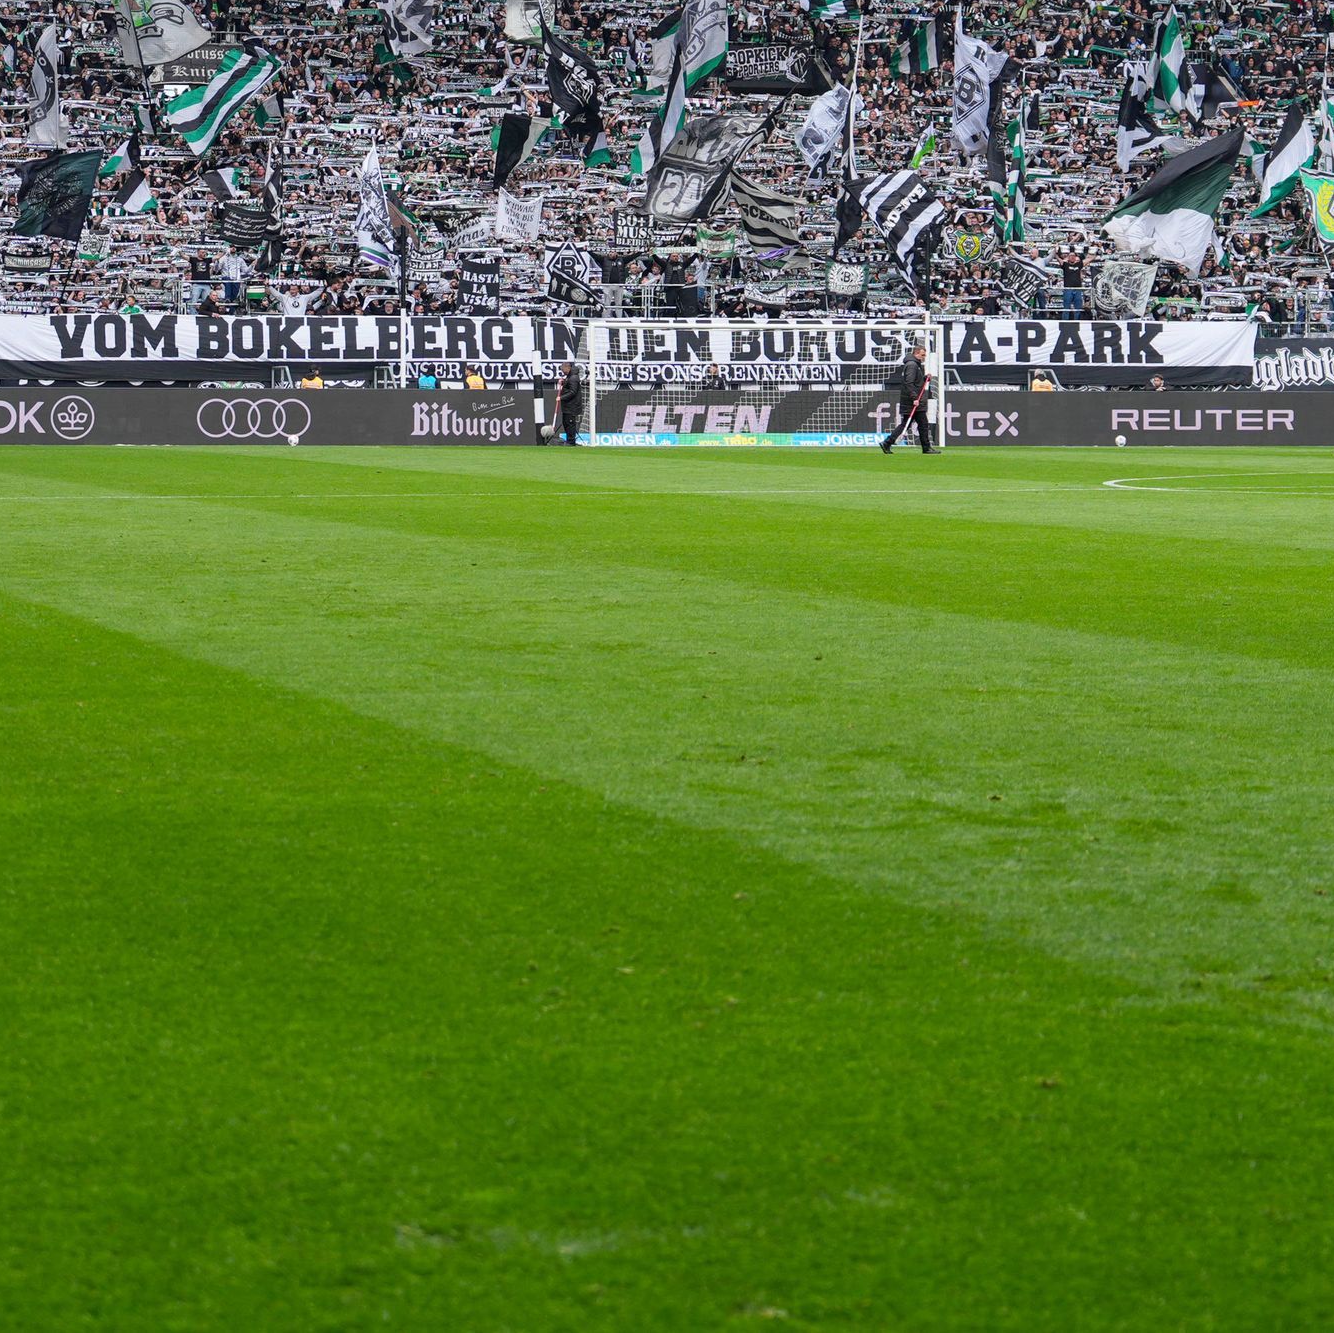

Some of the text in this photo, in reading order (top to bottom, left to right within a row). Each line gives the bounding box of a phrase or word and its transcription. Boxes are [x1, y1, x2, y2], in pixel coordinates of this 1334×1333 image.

[617, 214, 655, 227] 50+1
[617, 226, 655, 239] MUSS
[463, 270, 499, 285] HASTA
[472, 283, 488, 295] LA
[462, 294, 498, 308] Vista
[50, 314, 178, 359] VOM
[195, 315, 514, 360] BOKELBERG
[531, 318, 581, 361] IN
[607, 318, 713, 363] DEN
[388, 362, 463, 380] UNSER
[636, 362, 841, 382] SPONSRENNAMEN!
[410, 401, 523, 441] Bitburger
[620, 405, 772, 434] ELTEN
[1111, 409, 1295, 431] REUTER
[597, 433, 656, 446] JONGEN
[723, 435, 757, 446] TRIBO
[825, 433, 885, 446] JONGEN
